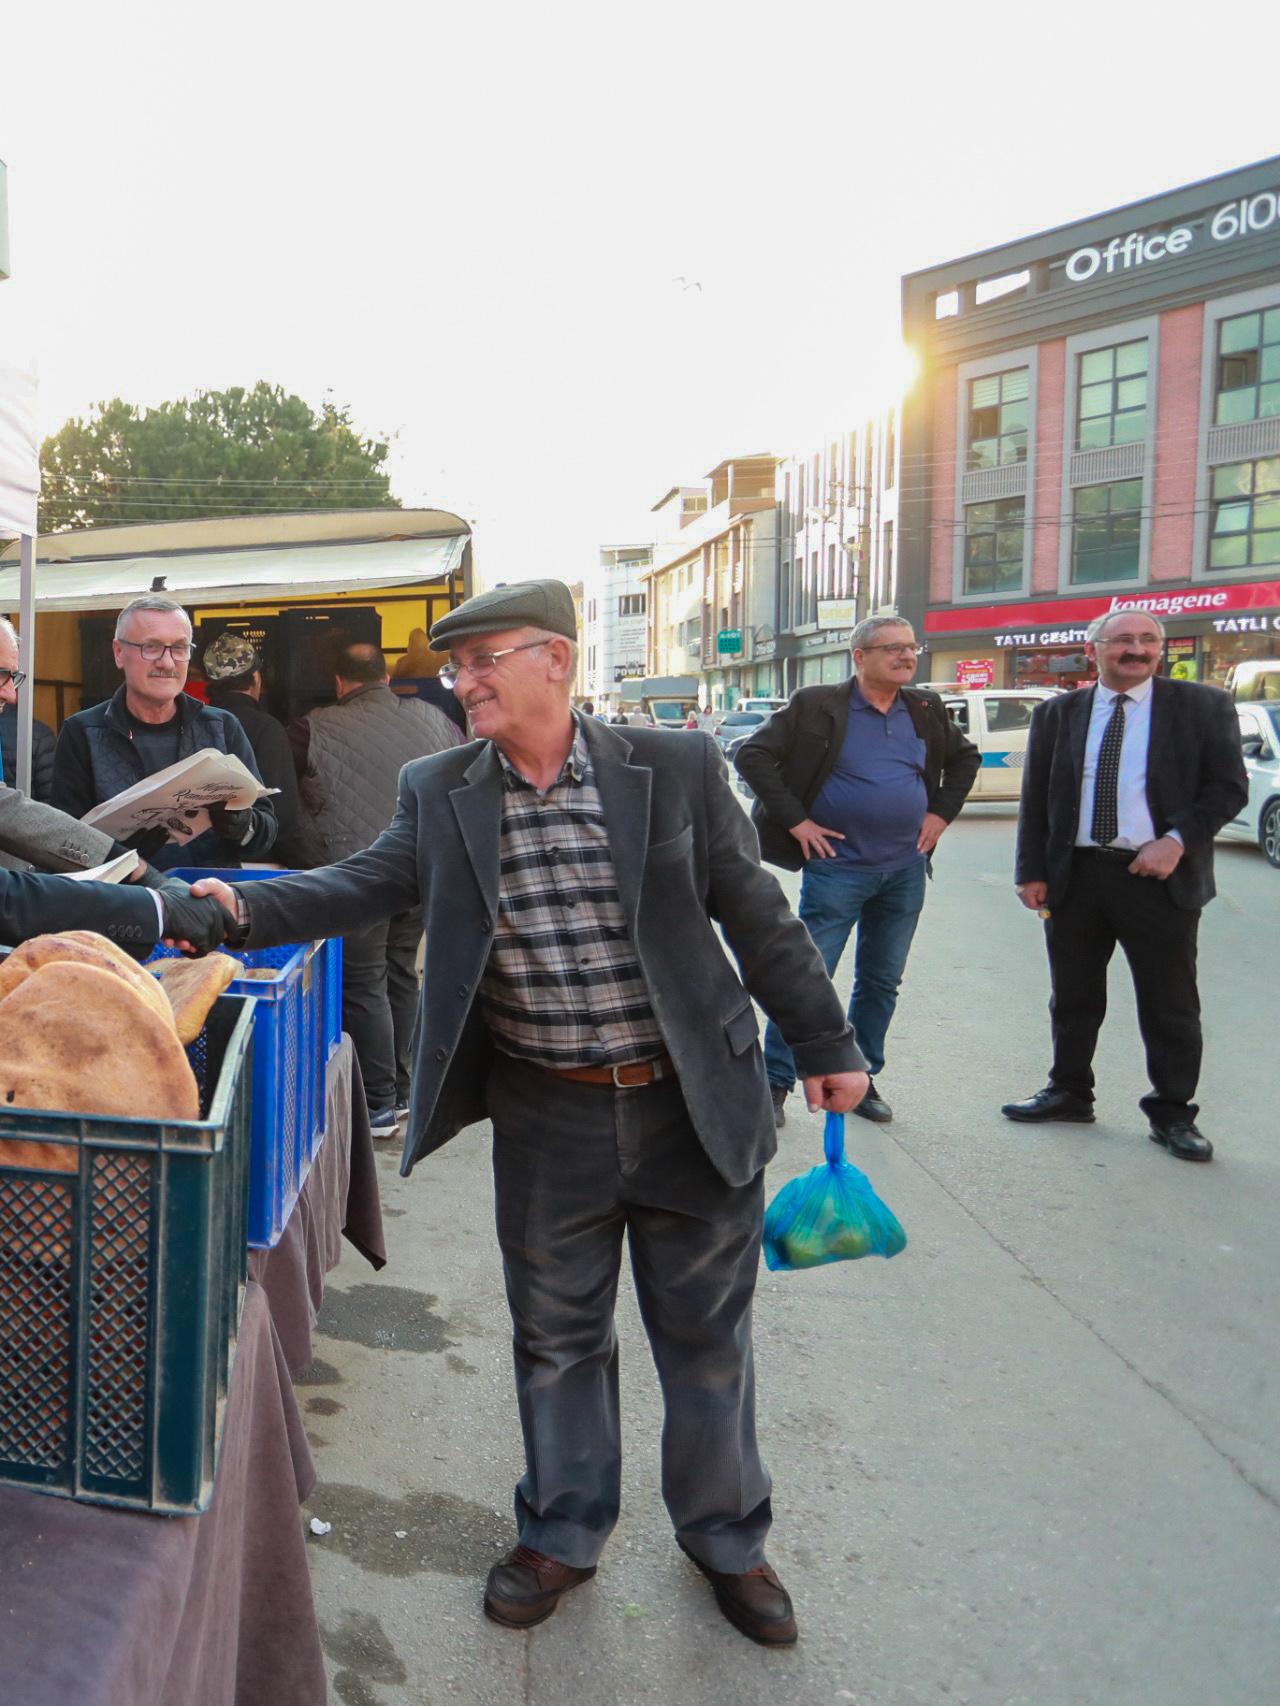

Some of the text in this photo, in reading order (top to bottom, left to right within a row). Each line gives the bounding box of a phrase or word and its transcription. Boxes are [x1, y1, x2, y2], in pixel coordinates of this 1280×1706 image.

[1066, 193, 1280, 281] Office 610
[1108, 591, 1228, 615] komagene
[1212, 616, 1268, 633] TATLI
[994, 633, 1036, 647] TATLI
